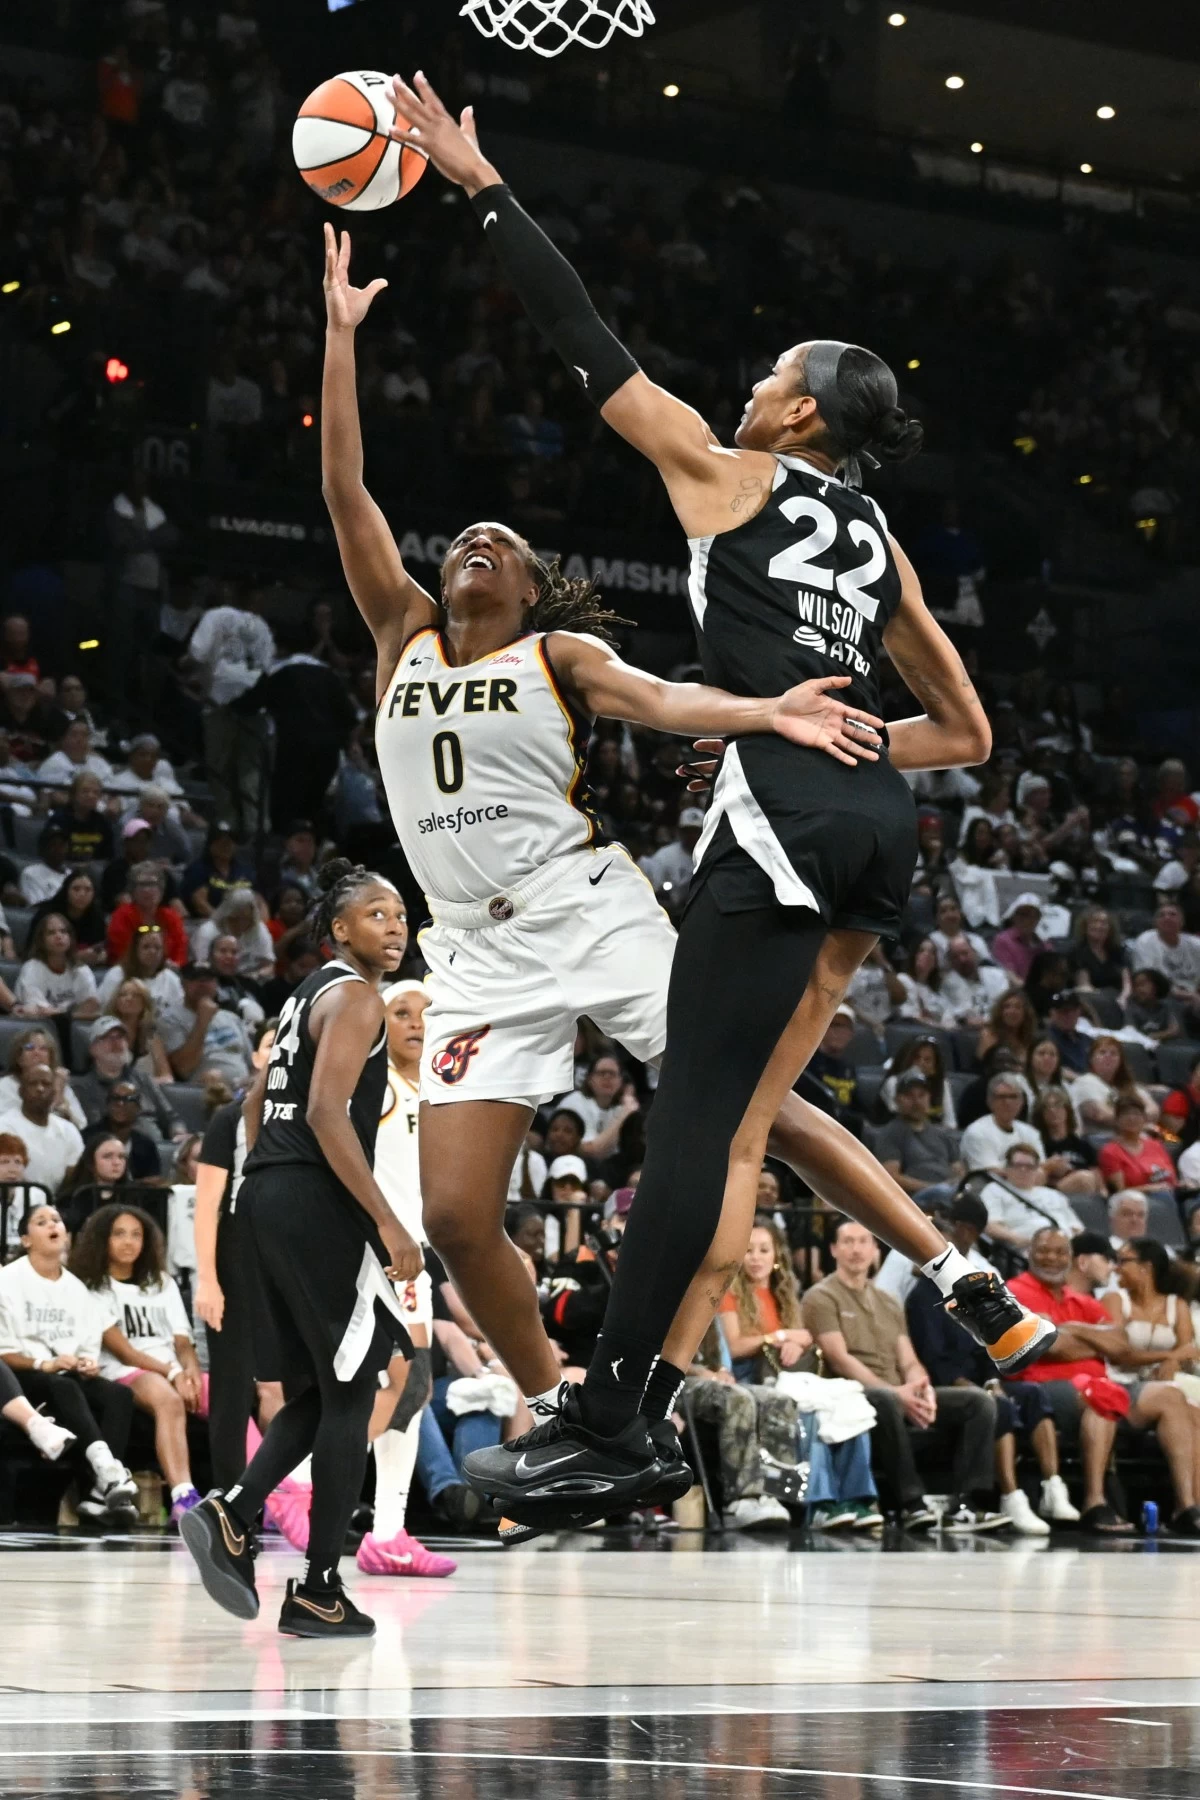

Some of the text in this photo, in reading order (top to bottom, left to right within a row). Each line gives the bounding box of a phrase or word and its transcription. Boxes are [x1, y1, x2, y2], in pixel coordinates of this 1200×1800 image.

[767, 495, 887, 623] 22
[797, 590, 864, 646] WILSON
[489, 652, 524, 666] Lilly
[387, 678, 522, 719] FEVER
[432, 730, 465, 795] 0
[417, 803, 509, 834] salesforce
